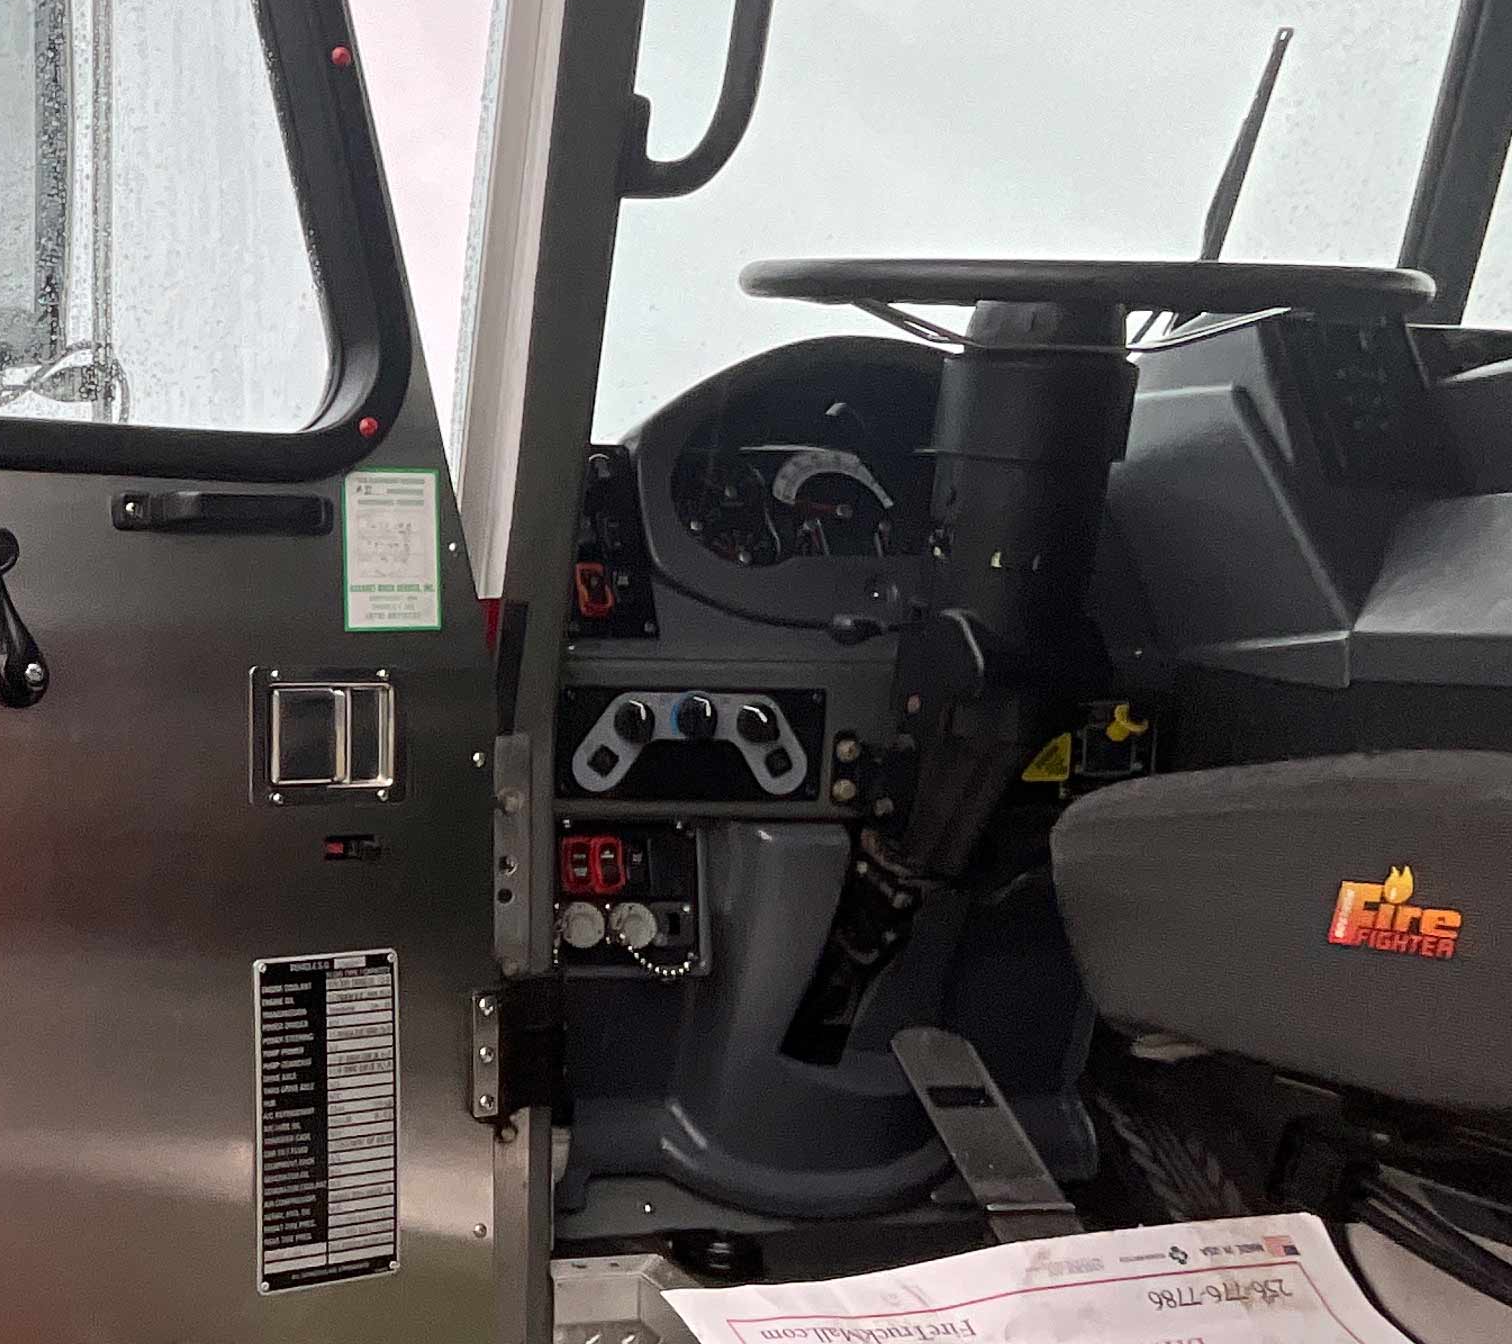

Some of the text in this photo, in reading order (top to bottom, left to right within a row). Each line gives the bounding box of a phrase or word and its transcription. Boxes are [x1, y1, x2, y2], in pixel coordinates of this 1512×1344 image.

[1328, 868, 1462, 946] Fire
[1355, 928, 1455, 959] FIGHTER
[1147, 1278, 1293, 1311] 256-776-7786
[760, 1319, 977, 1344] FireTruckMall.com
